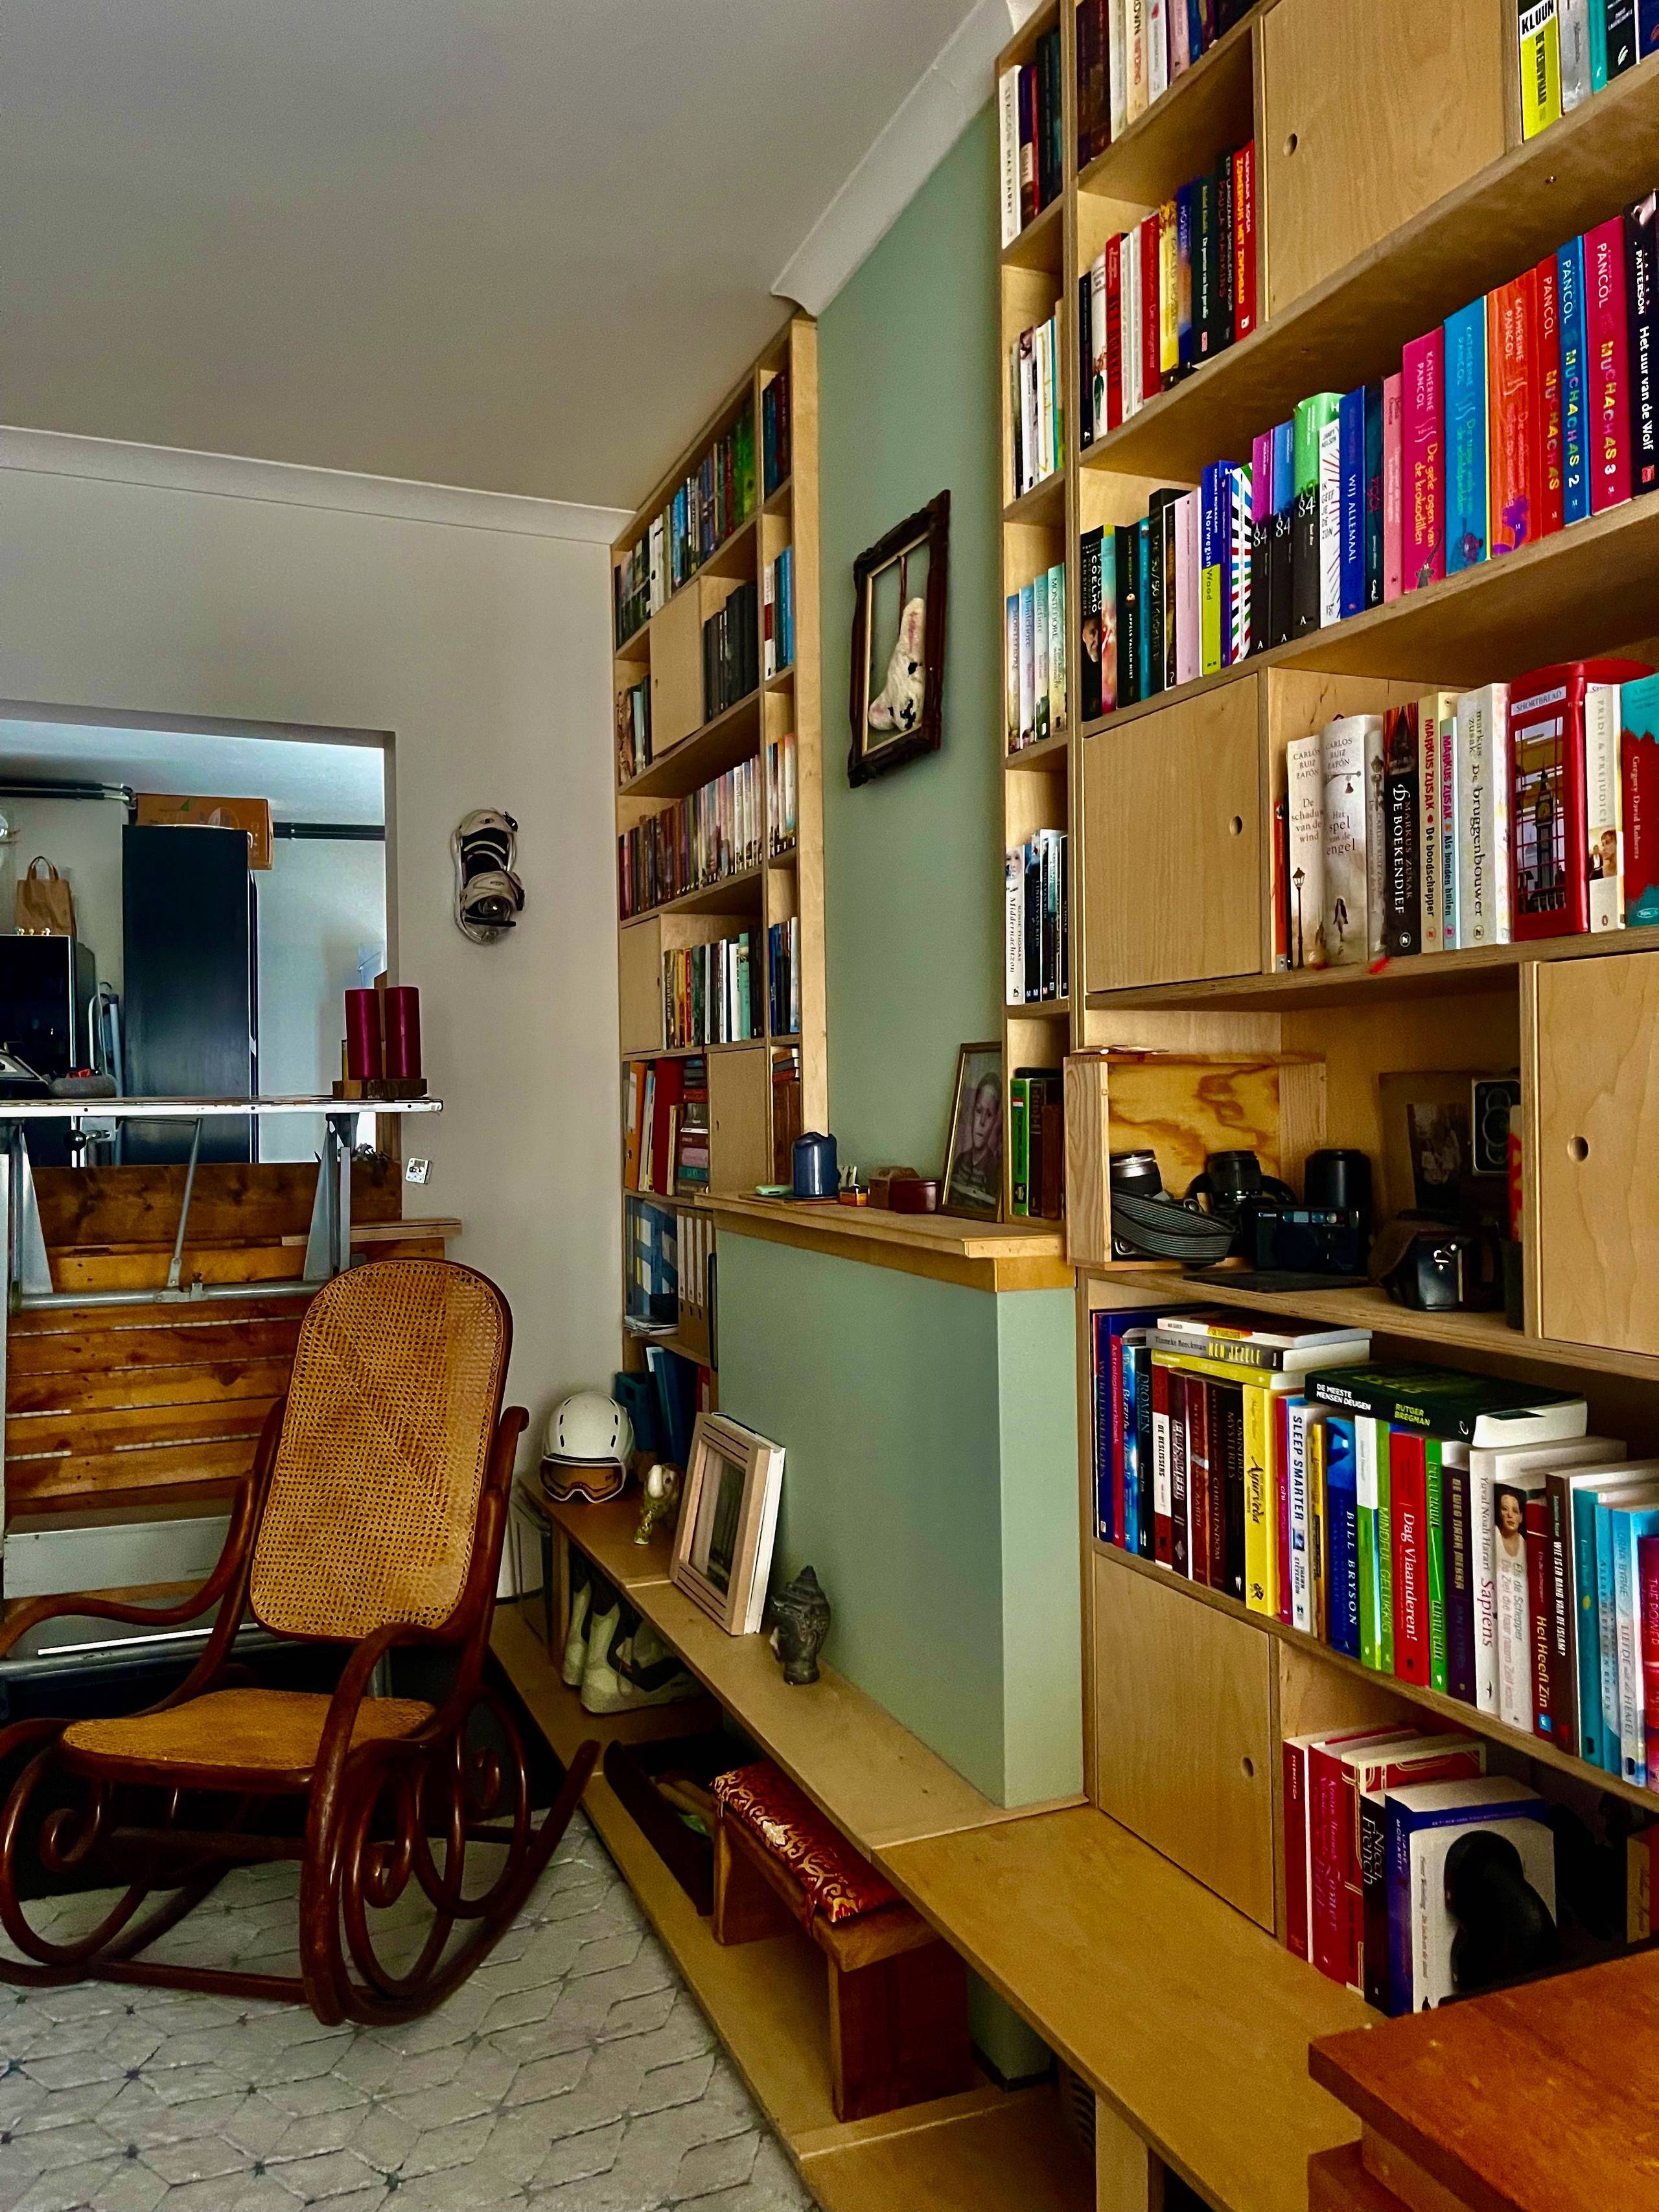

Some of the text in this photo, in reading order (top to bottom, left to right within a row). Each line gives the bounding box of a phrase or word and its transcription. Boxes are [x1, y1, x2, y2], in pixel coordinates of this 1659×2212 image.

[1522, 0, 1554, 35] KLUUN
[1218, 180, 1227, 298] PAULA HAWKINS
[1504, 309, 1514, 360] PANCOL
[1515, 297, 1525, 363] KATHERINE
[1635, 250, 1654, 452] PATTERSON Het uur van de Wolf
[1457, 336, 1465, 386] PANCOL
[1465, 326, 1474, 388] KATHERINE
[1562, 259, 1581, 489] PANCOL MUCHACHAS 2
[1596, 243, 1617, 476] PANCOL MUCHACHAS 3
[1416, 363, 1425, 410] PANCOL
[1425, 351, 1435, 412] KATHERINE
[1544, 276, 1560, 492] PANCOL MUCHACHAS
[1322, 489, 1334, 504] GEEF
[1347, 474, 1356, 497] WIJ
[1414, 462, 1424, 545] de krokodillen
[1424, 443, 1437, 547] De gele ogen van
[1204, 509, 1212, 567] Norwegian
[1348, 502, 1357, 564] ALLEMAAL
[1516, 690, 1562, 712] SHORTBREAD
[1293, 748, 1321, 760] CARLOS
[1325, 738, 1352, 751] CARLOS
[1329, 749, 1347, 760] RUIZ
[1468, 718, 1478, 754] zusak
[1474, 710, 1485, 756] markus
[1299, 759, 1316, 769] RUIZ
[1303, 798, 1314, 808] De
[1598, 756, 1608, 824] PREJUDICE
[1630, 756, 1642, 860] Gregory David Roberts
[1291, 808, 1324, 821] schaduw
[1295, 819, 1322, 832] van de
[1299, 830, 1319, 843] wind
[1328, 815, 1351, 835] spel
[1332, 811, 1345, 821] Het
[1424, 718, 1436, 916] MARKUS ZUSAK De boodschapper
[1442, 734, 1454, 916] MARKUS ZUSAK Als honden huilen
[1327, 837, 1356, 856] engel
[1392, 784, 1411, 914] DE BOEKENDIEF
[1404, 801, 1413, 900] MARKUS ZUSAK
[1470, 763, 1487, 917] De bruggenbouwer
[1111, 1344, 1120, 1445] Astrologiewerkboek
[1140, 1373, 1150, 1434] DROMEN
[1316, 1382, 1352, 1399] DE MEESTE
[1316, 1390, 1372, 1412] MENSEN DEUGEN
[1395, 1403, 1425, 1417] RUTGER
[1394, 1410, 1431, 1427] BREGMAN
[1247, 1455, 1264, 1524] Ayurveda
[1293, 1415, 1304, 1520] SLEEP SMARTER
[1452, 1478, 1464, 1590] DE WEG NAAR MEKKA
[1553, 1540, 1562, 1558] WIE
[1346, 1511, 1357, 1624] BILL BRYSON
[1378, 1506, 1392, 1633] MINDFUL GELUKKIG
[1400, 1511, 1418, 1642] Dag Vlaanderen!
[1476, 1476, 1495, 1647] Yuval Noah Harari Sapiens
[1501, 1559, 1512, 1573] De
[1501, 1574, 1512, 1593] Ziel
[1619, 1563, 1629, 1597] BYRNE
[1502, 1598, 1513, 1611] die
[1513, 1563, 1525, 1642] Els de Schepper
[1555, 1599, 1565, 1615] VAN
[1555, 1616, 1565, 1626] DE
[1648, 1578, 1659, 1646] THE POWER
[1536, 1616, 1548, 1642] Het
[1557, 1626, 1566, 1656] ISLAM?
[1620, 1625, 1631, 1664] LIEFDE
[1537, 1644, 1549, 1684] Heeft
[1538, 1684, 1550, 1708] Zin
[1362, 1815, 1376, 1885] French
[1374, 1831, 1385, 1878] Nicci
